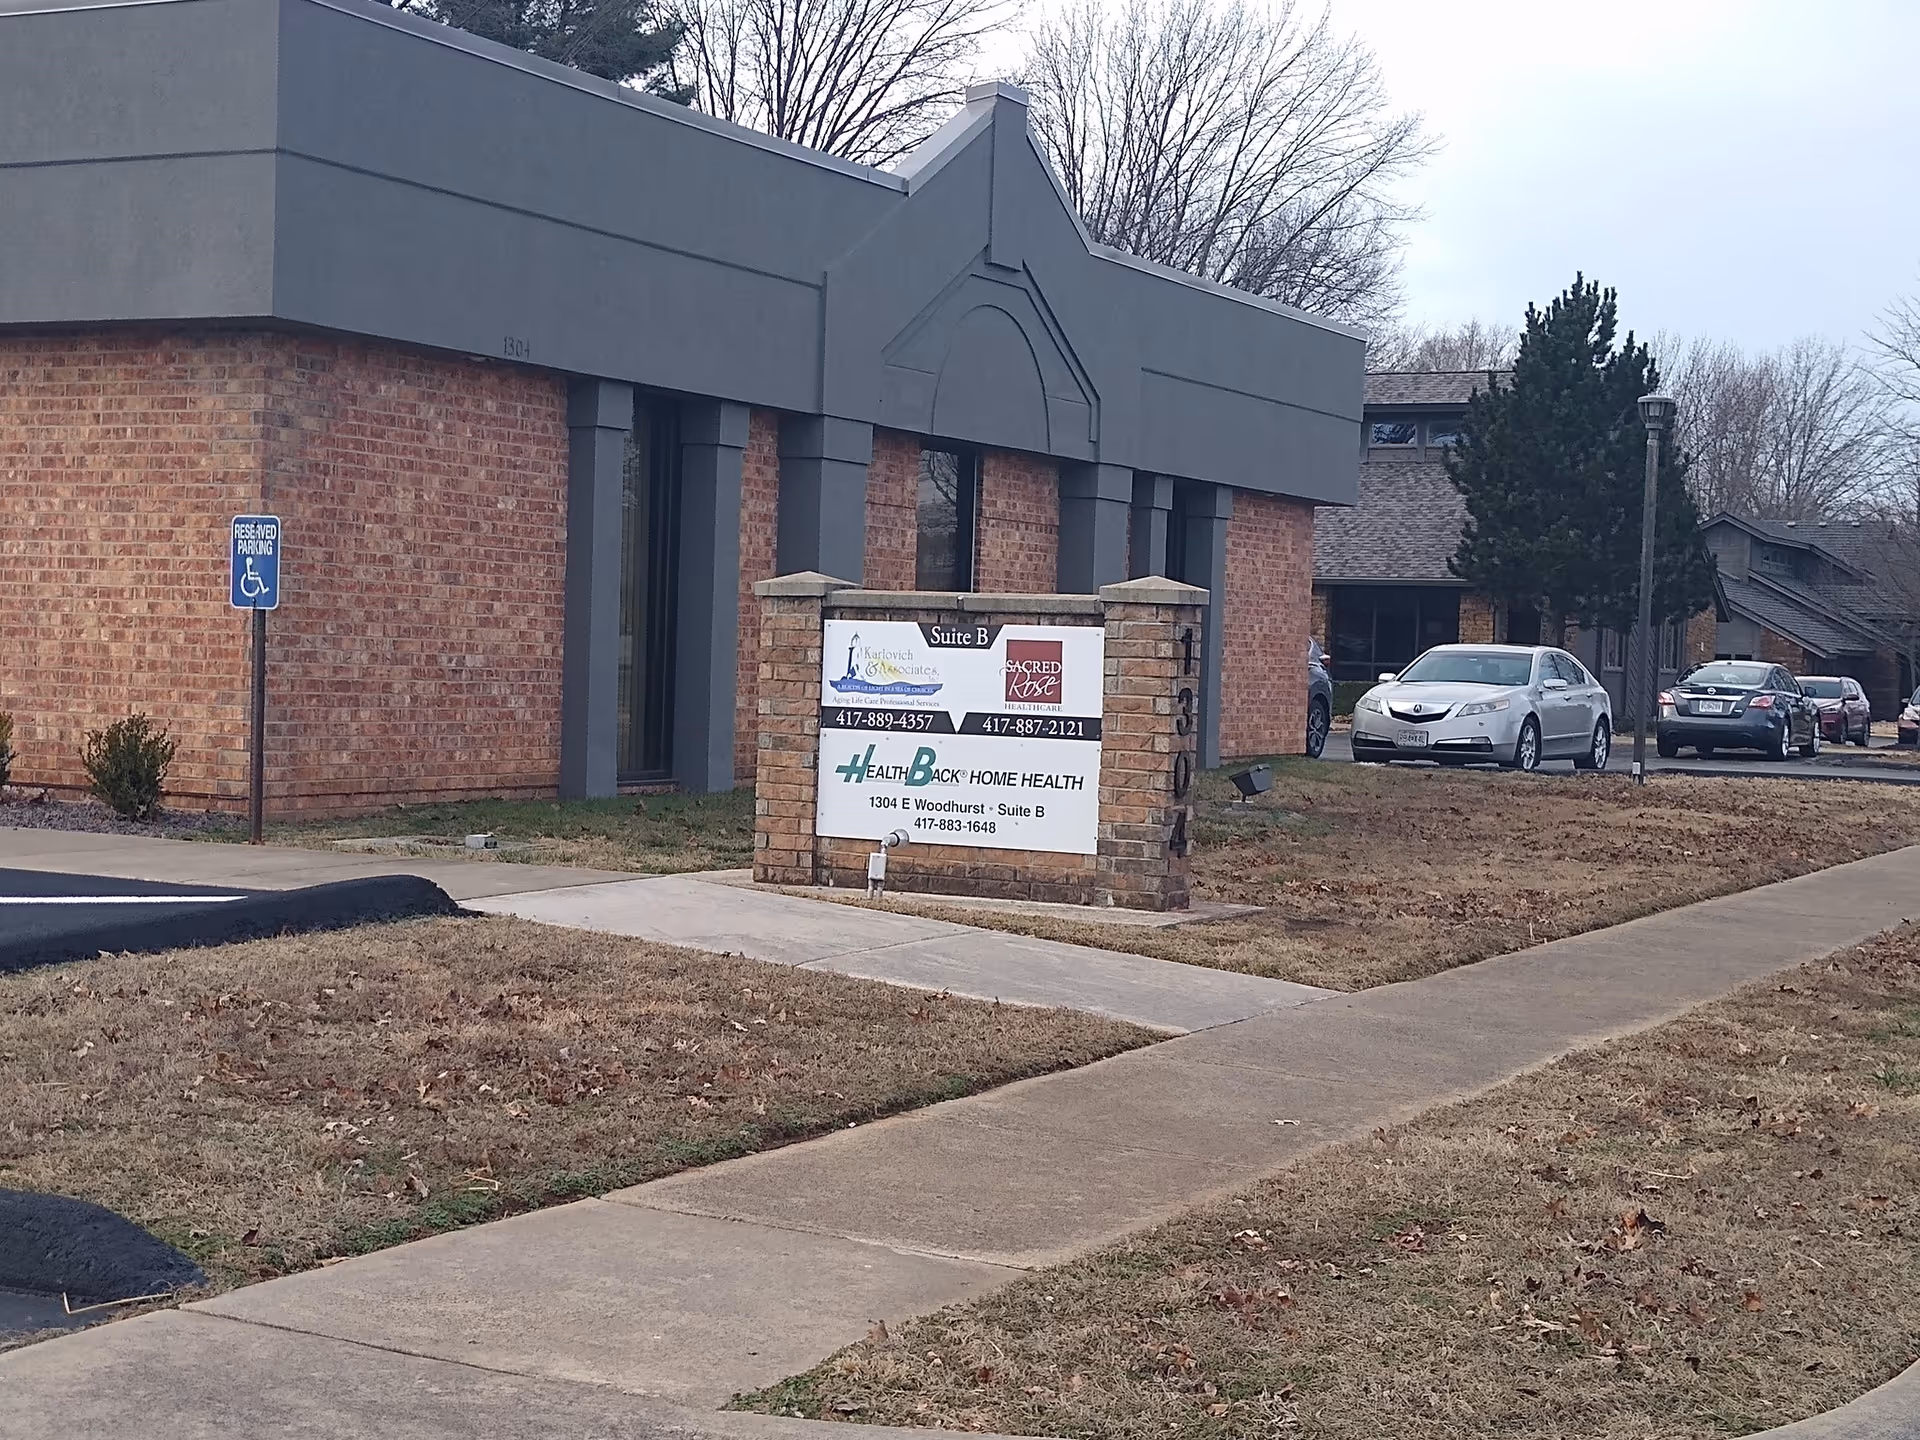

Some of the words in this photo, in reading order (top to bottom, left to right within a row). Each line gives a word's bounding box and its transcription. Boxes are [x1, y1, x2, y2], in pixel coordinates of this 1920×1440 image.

[503, 336, 531, 359] 1304
[234, 524, 277, 540] RESERVED
[237, 540, 273, 555] PARKING
[930, 625, 971, 645] Suite
[976, 627, 989, 645] B
[864, 646, 914, 660] Karlovich
[1006, 659, 1062, 674] SACRED
[999, 665, 1061, 699] Rose
[832, 696, 851, 705] Aging
[851, 696, 864, 704] Life
[864, 697, 879, 705] Care
[879, 697, 915, 706] Professional
[915, 699, 940, 707] Services
[1004, 703, 1063, 712] HEALTHCARE
[835, 709, 934, 730] 417-889-4357
[982, 716, 1084, 736] 417-887-2121
[1169, 628, 1193, 858] 1304
[969, 770, 1018, 787] HOME
[1020, 773, 1084, 790] HEALTH
[869, 796, 898, 809] 1304
[901, 798, 911, 809] E
[914, 798, 985, 814] Woodhurst
[997, 803, 1031, 817] Suite
[1035, 805, 1045, 818] B
[914, 817, 996, 834] 417-883-1648
